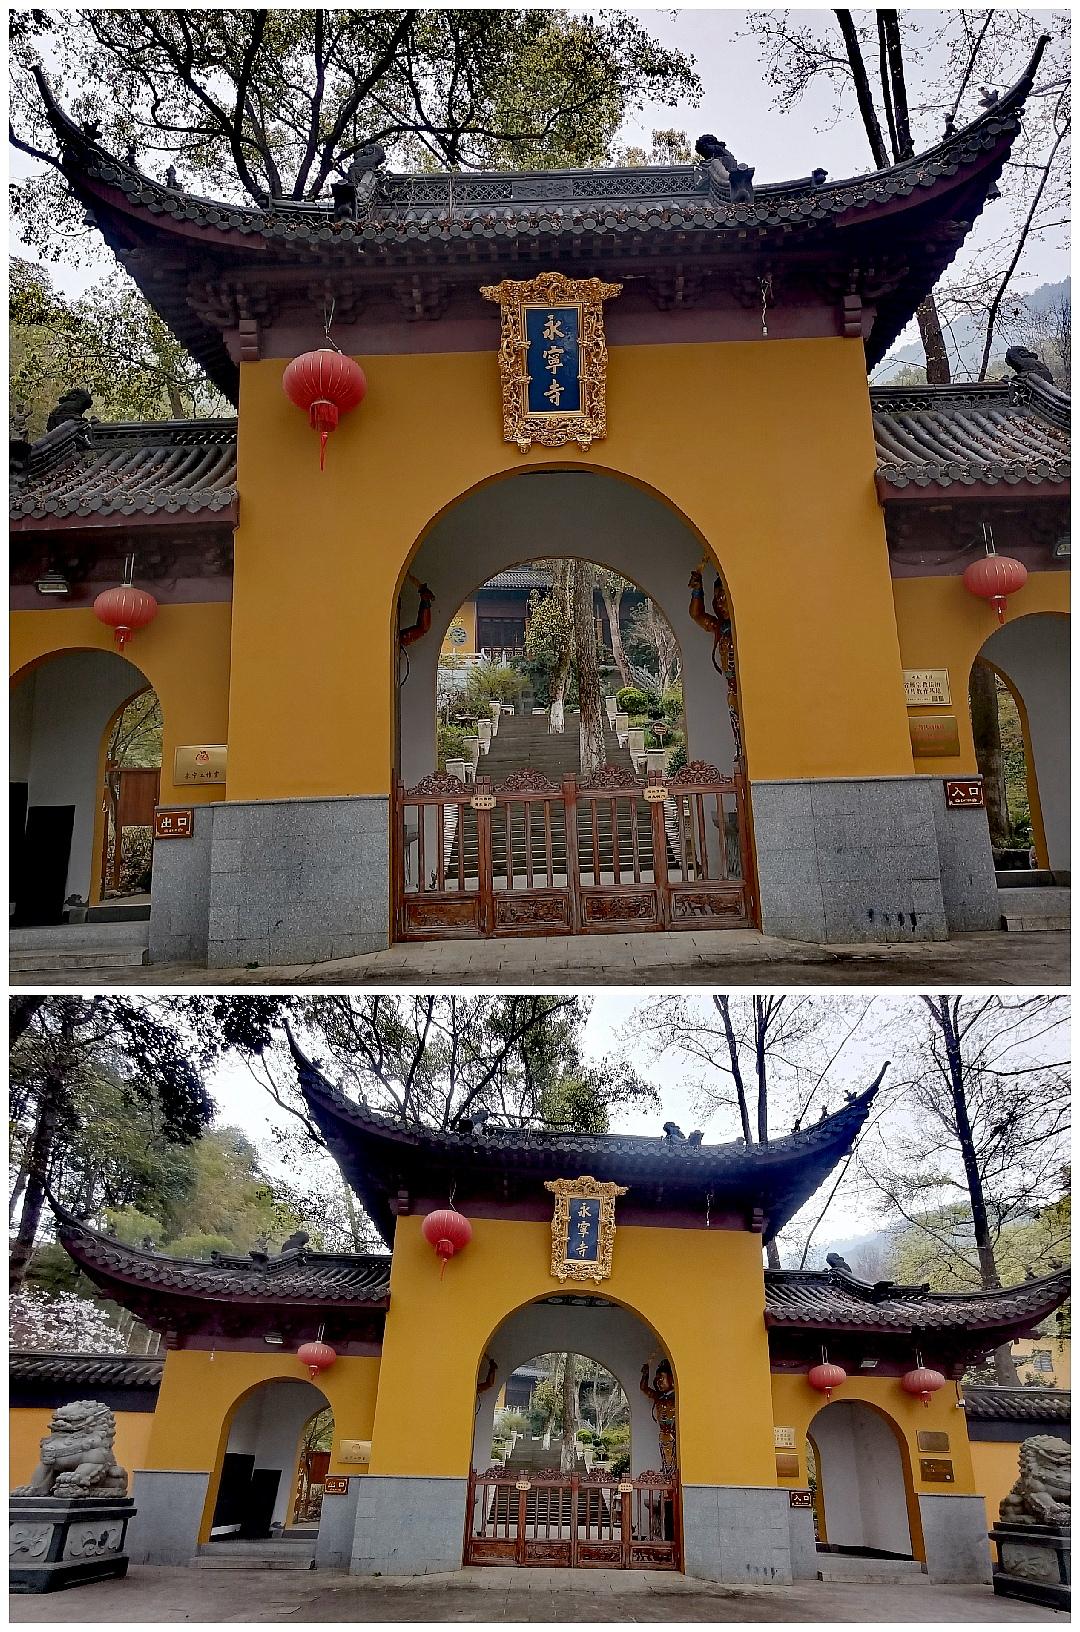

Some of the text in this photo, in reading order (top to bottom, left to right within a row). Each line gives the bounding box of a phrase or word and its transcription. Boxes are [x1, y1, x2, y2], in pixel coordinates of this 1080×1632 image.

[951, 786, 979, 797] 入口
[160, 817, 187, 828] 出口
[793, 1494, 810, 1502] 入口
